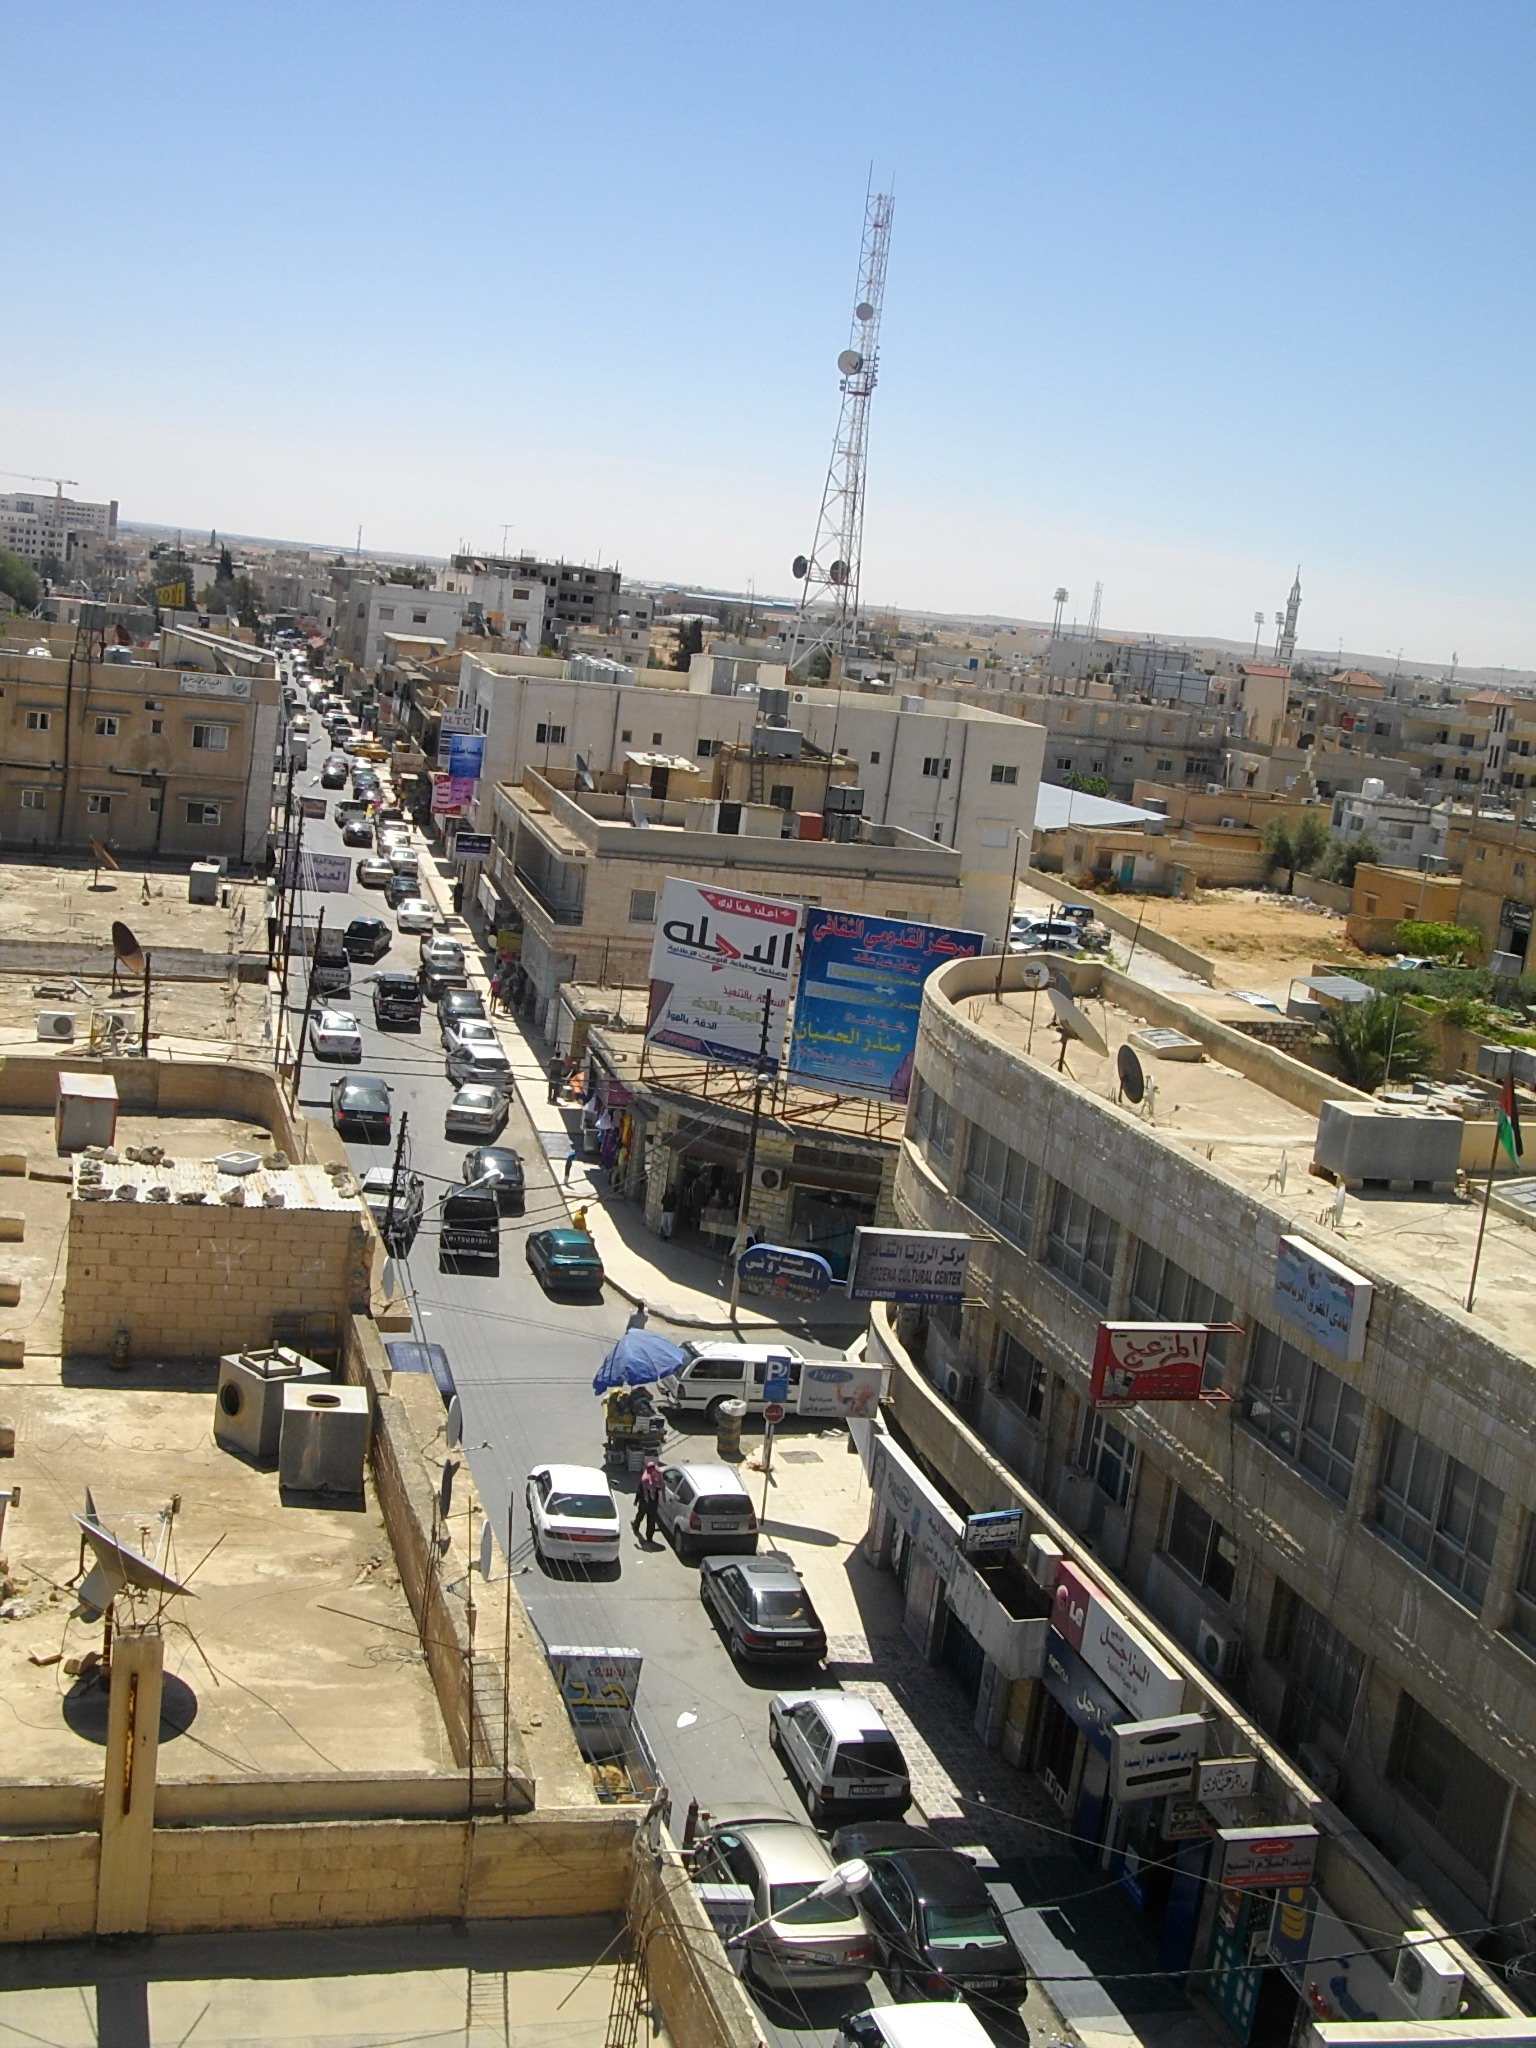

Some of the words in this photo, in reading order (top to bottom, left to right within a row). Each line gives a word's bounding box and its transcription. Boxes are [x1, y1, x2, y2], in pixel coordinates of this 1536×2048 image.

[443, 715, 471, 726] MTC
[736, 901, 752, 913] هنا
[812, 915, 864, 942] الثقافي
[863, 927, 925, 948] القدومي
[923, 933, 975, 958] مركز
[723, 985, 752, 1000] بالتنفيذ
[388, 1004, 414, 1012] TOYOTA
[694, 1019, 717, 1030] الدقة
[448, 1236, 491, 1244] MITSUBISHI
[766, 1253, 804, 1266] صيدلية
[938, 1245, 966, 1267] مركز
[898, 1266, 932, 1285] CULTURAL
[934, 1270, 962, 1286] CENTER
[1124, 1334, 1198, 1369] المزعج
[767, 1361, 783, 1381] P
[1069, 1601, 1084, 1628] LG
[1100, 1626, 1150, 1686] الزاجل
[1048, 1654, 1069, 1685] NOKIA
